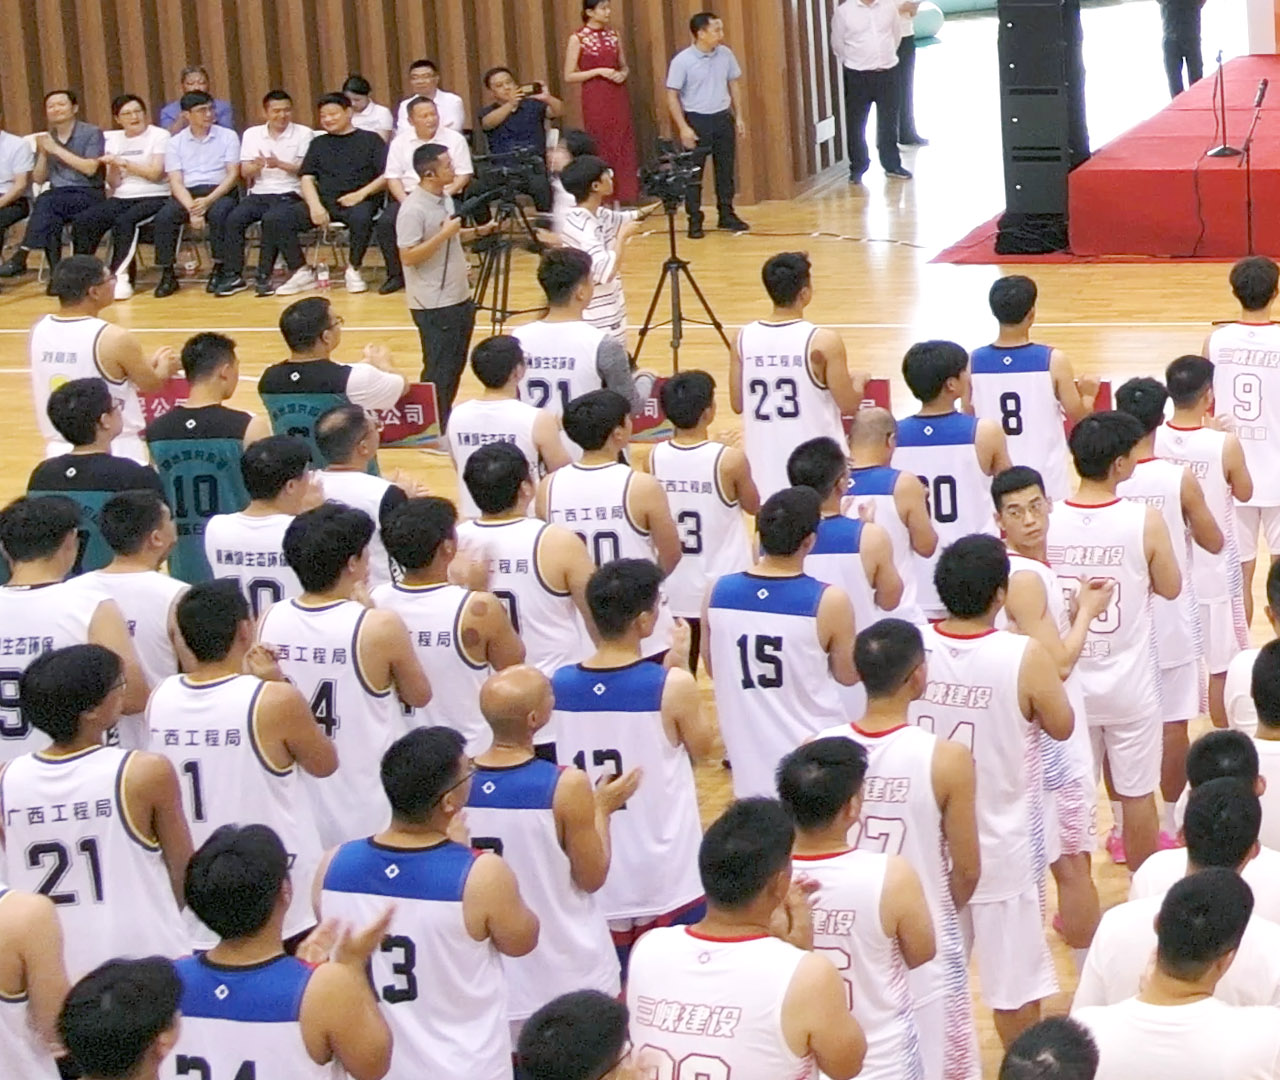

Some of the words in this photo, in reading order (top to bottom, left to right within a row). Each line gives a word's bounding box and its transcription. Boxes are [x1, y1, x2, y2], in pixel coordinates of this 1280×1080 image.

[748, 377, 801, 422] 23
[1000, 391, 1023, 436] 8
[1233, 373, 1263, 422] 9
[173, 474, 219, 518] 10
[487, 557, 529, 575] 程局
[1047, 545, 1124, 567] 三峡建设
[276, 643, 348, 666] 西工程局
[406, 631, 451, 649] 程局
[736, 633, 783, 690] 15
[921, 681, 993, 710] 峡建设
[7, 798, 113, 827] 广西工程局
[181, 759, 206, 824] 1
[25, 835, 105, 907] 21
[636, 995, 742, 1039] 三峡建设
